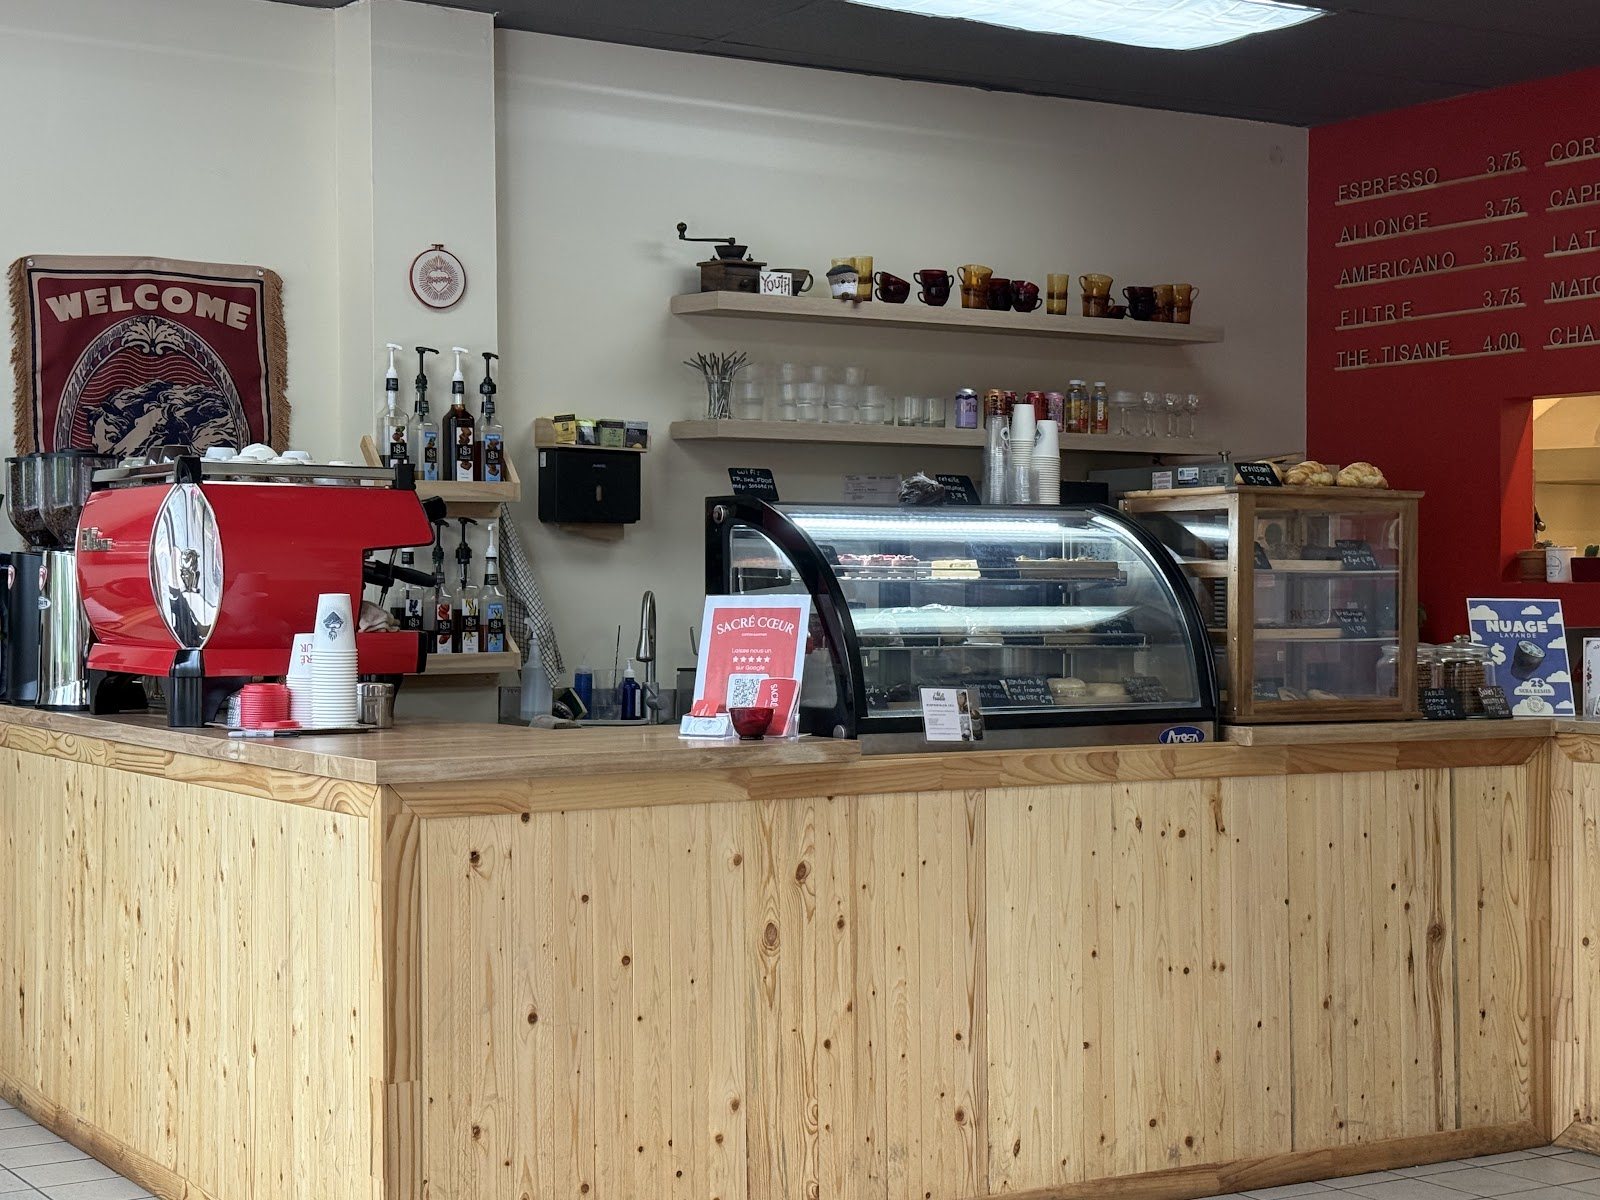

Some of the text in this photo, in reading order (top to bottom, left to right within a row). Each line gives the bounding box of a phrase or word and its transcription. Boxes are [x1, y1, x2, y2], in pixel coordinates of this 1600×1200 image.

[1550, 136, 1600, 161] COR
[1338, 151, 1521, 201] ESPRESSO 3.75
[1340, 197, 1520, 244] ALLONGE 3.75
[1340, 241, 1520, 285] AMERICANO 3.75
[46, 284, 251, 331] WELCOME
[1341, 287, 1520, 328] FILTRE 3.75
[1483, 332, 1519, 353] 4.00
[716, 615, 795, 635] SACRÉ CŒUR
[1485, 620, 1548, 633] NUAGE
